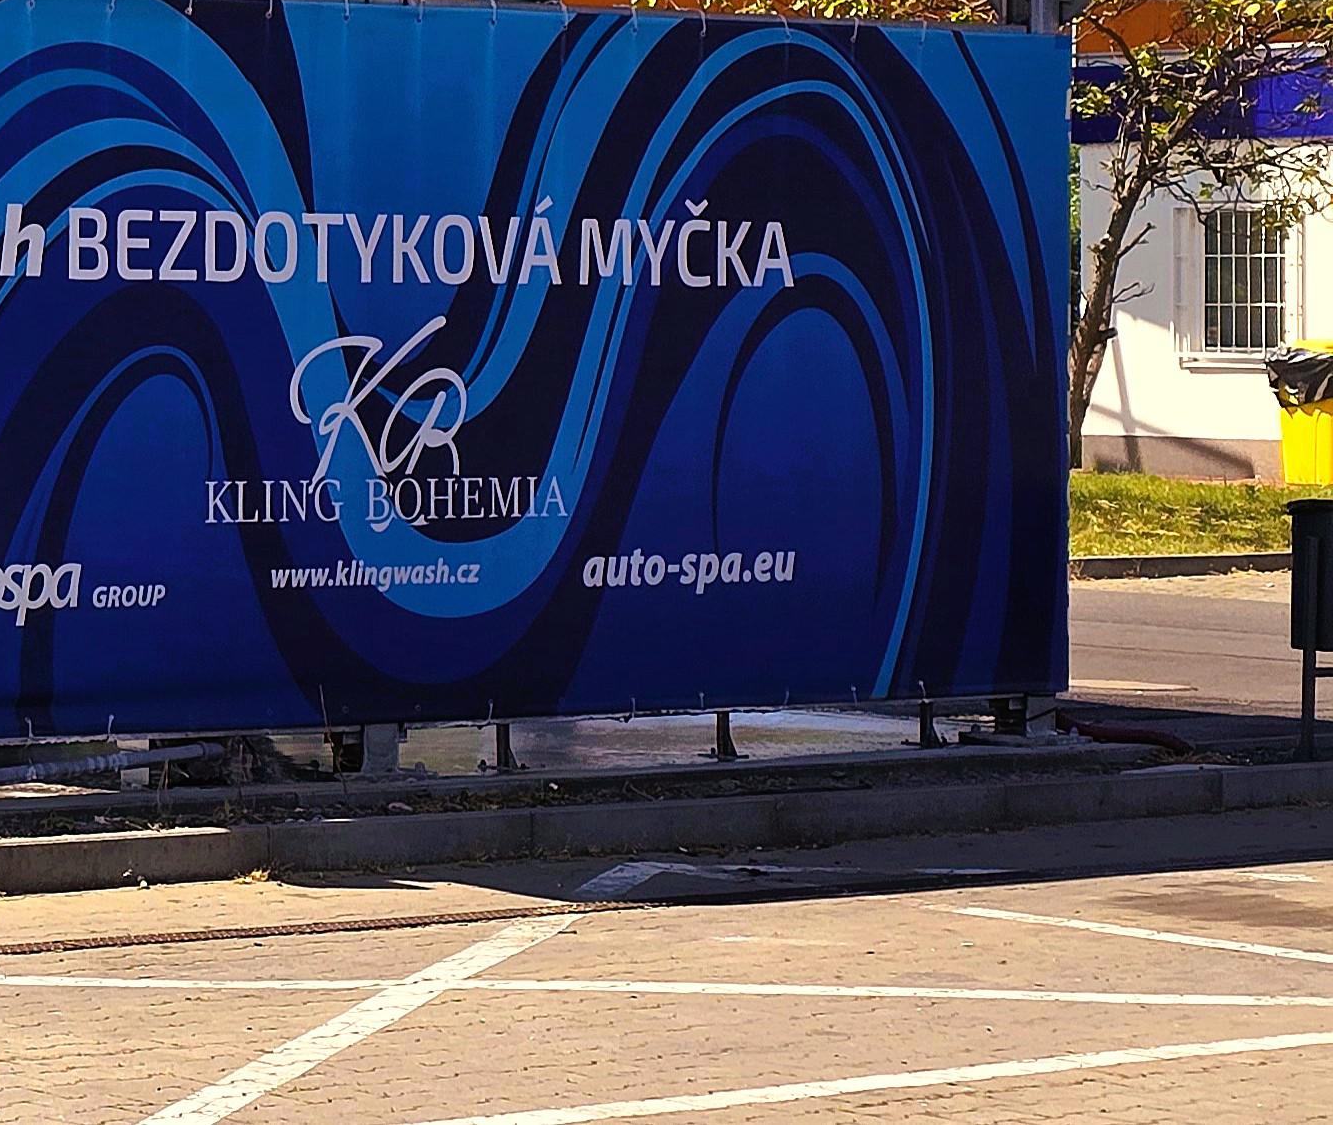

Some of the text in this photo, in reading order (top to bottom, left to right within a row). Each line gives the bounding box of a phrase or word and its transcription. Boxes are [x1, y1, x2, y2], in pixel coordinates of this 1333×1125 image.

[69, 195, 562, 286] BEZDOTYKOVÁ
[579, 199, 794, 287] MYČKA
[205, 476, 568, 526] KLING BOHEMIA
[271, 557, 480, 591] www.klingwash.cz
[583, 548, 795, 594] auto-spa.eu
[92, 584, 166, 608] GROUP
